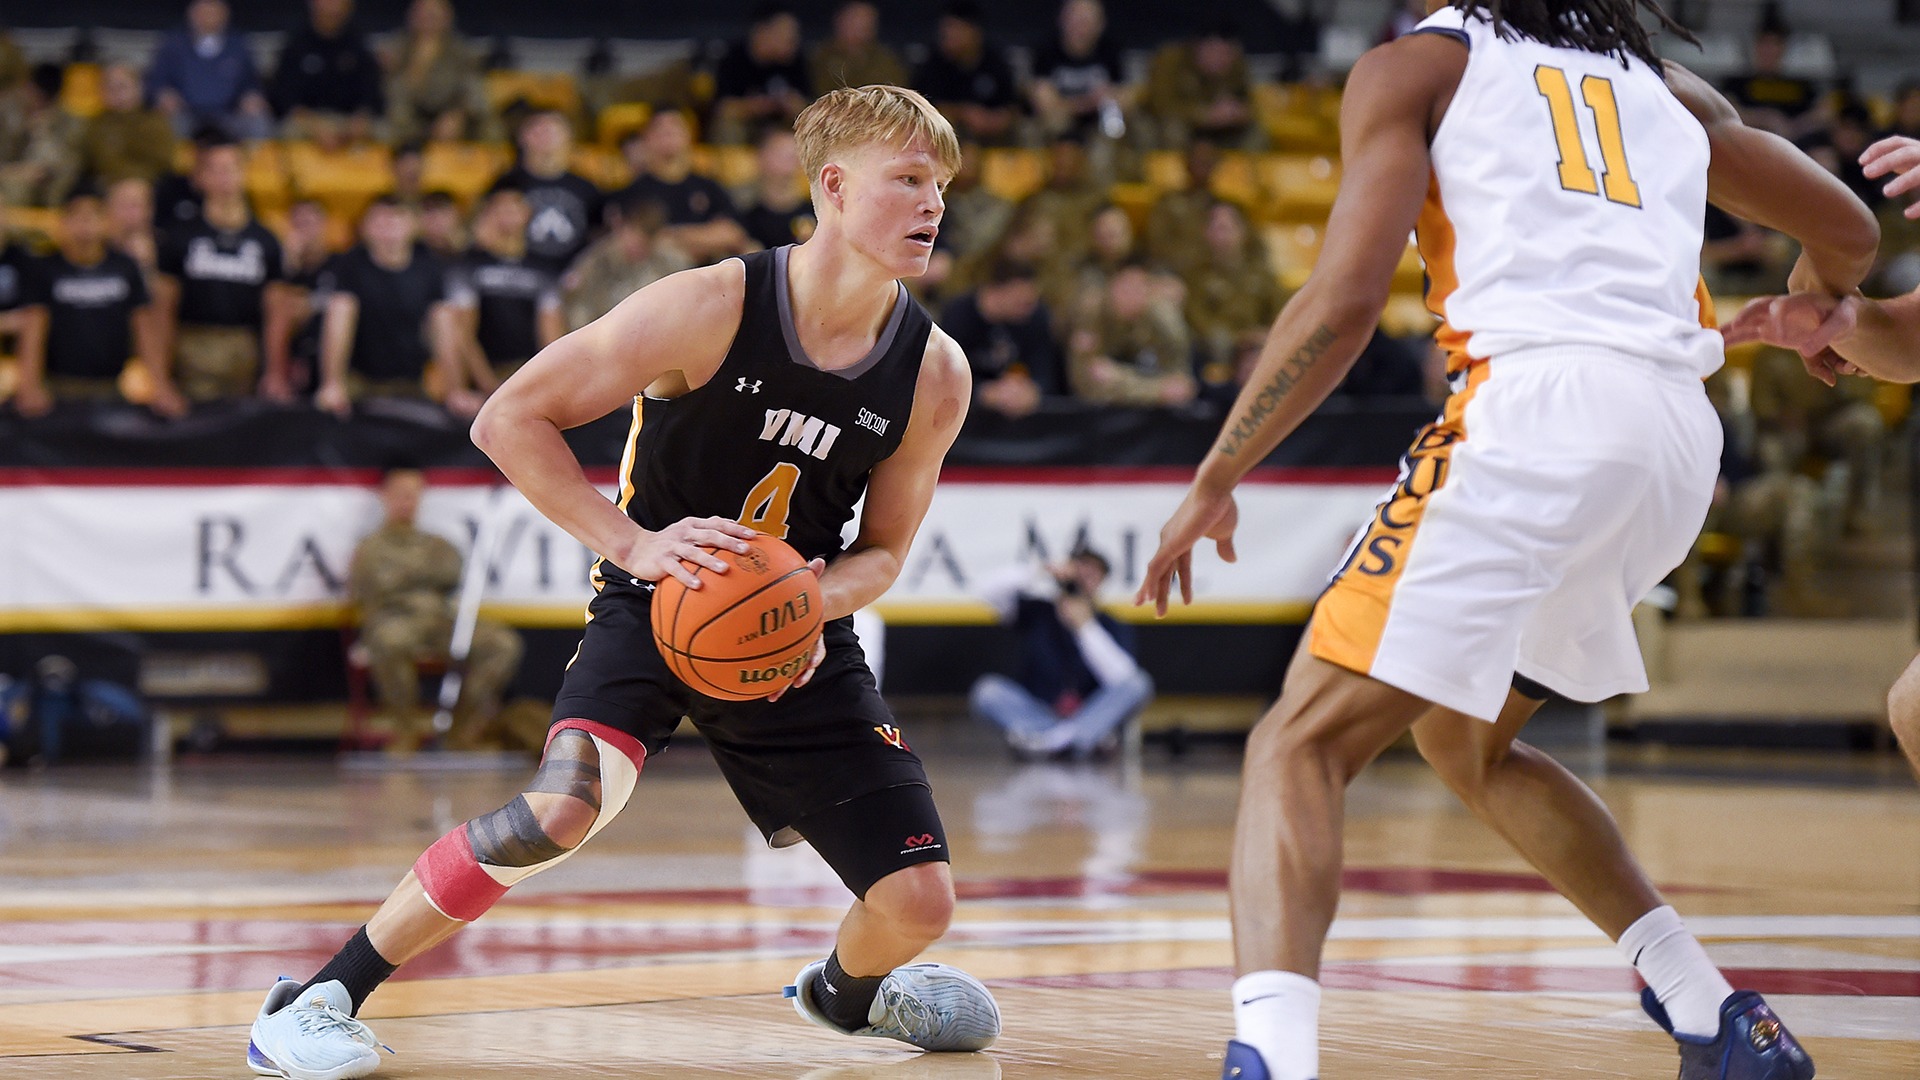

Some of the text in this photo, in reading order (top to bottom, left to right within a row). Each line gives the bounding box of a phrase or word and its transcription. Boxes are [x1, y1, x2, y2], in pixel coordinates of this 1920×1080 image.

[1533, 63, 1643, 210] 11
[758, 408, 842, 461] VMI
[736, 461, 802, 540] 4
[1357, 426, 1461, 578] BUCS
[760, 591, 810, 637] EVO
